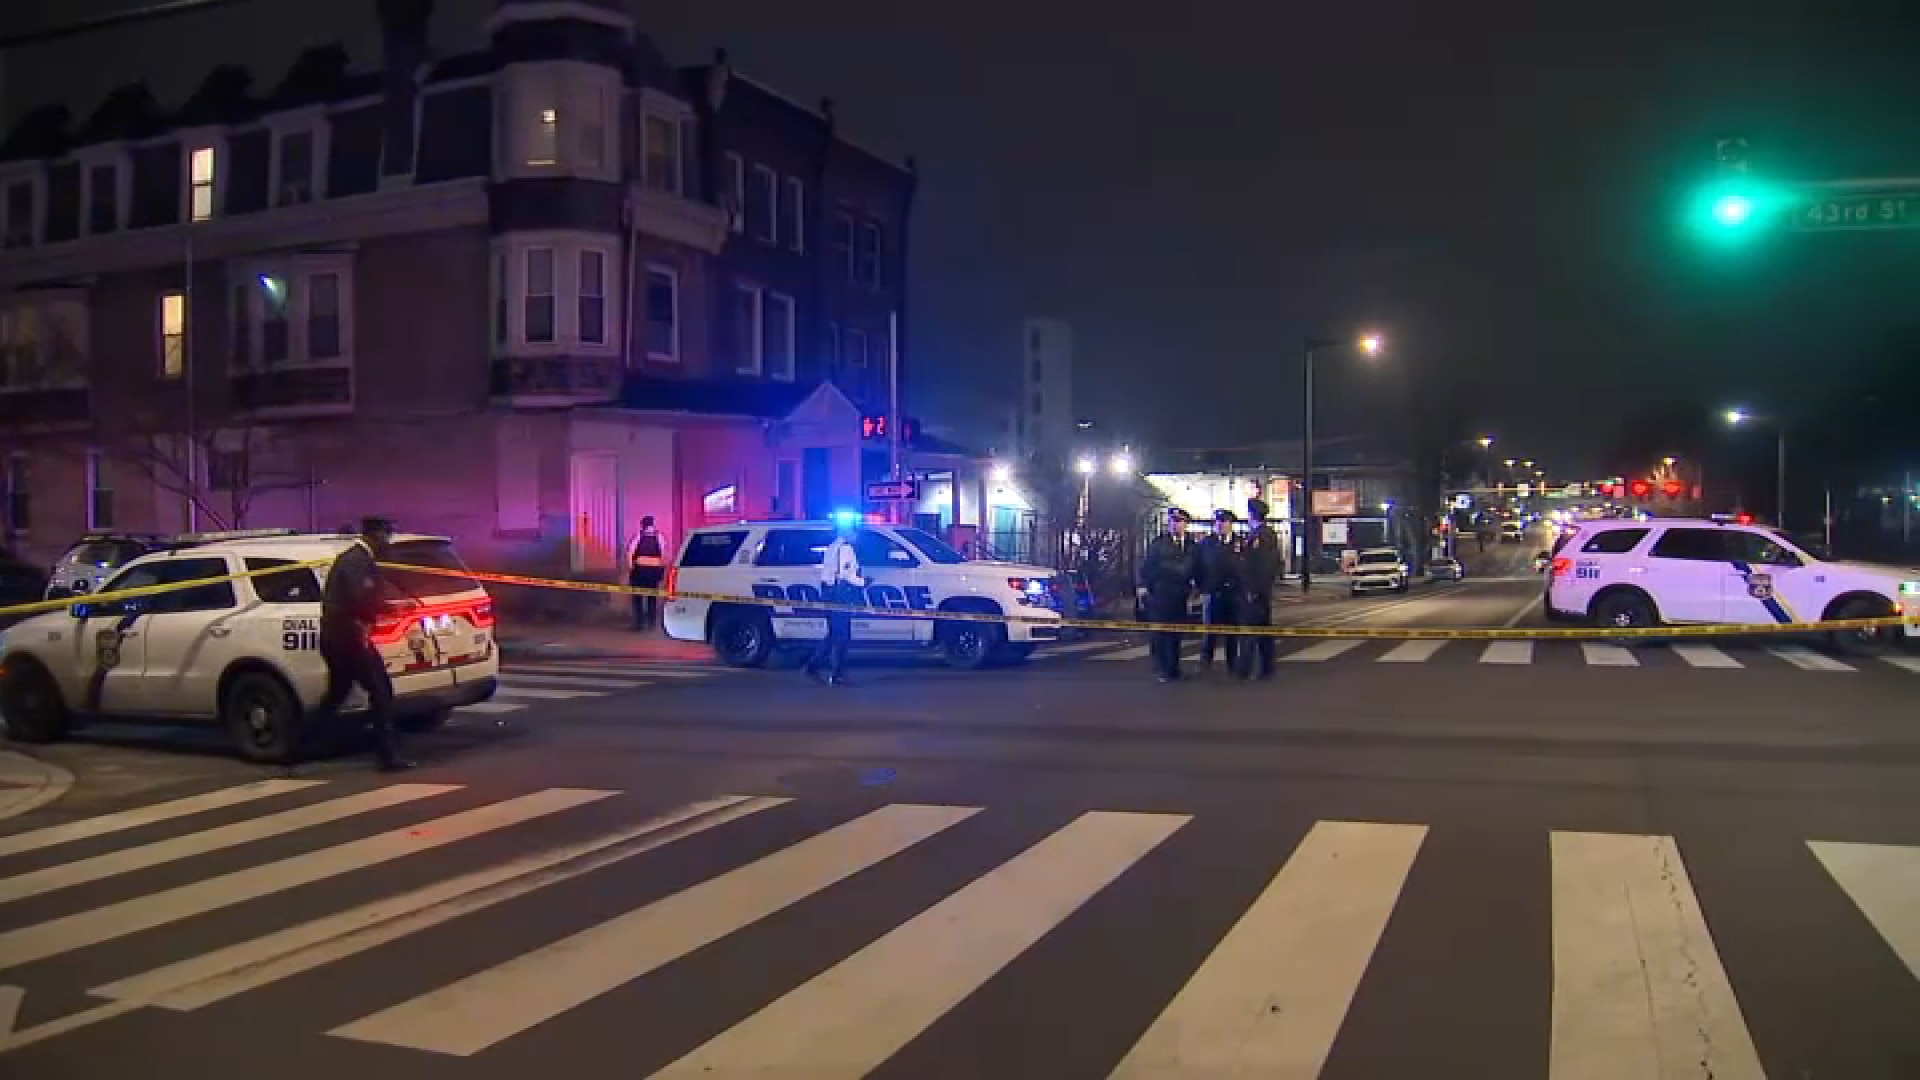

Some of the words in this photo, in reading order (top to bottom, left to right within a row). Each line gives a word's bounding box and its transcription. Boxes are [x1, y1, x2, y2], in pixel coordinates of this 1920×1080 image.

[1807, 202, 1869, 224] 43rd
[1879, 199, 1905, 219] St
[1575, 567, 1601, 579] 911
[282, 619, 318, 632] DIAL
[282, 632, 320, 650] 911
